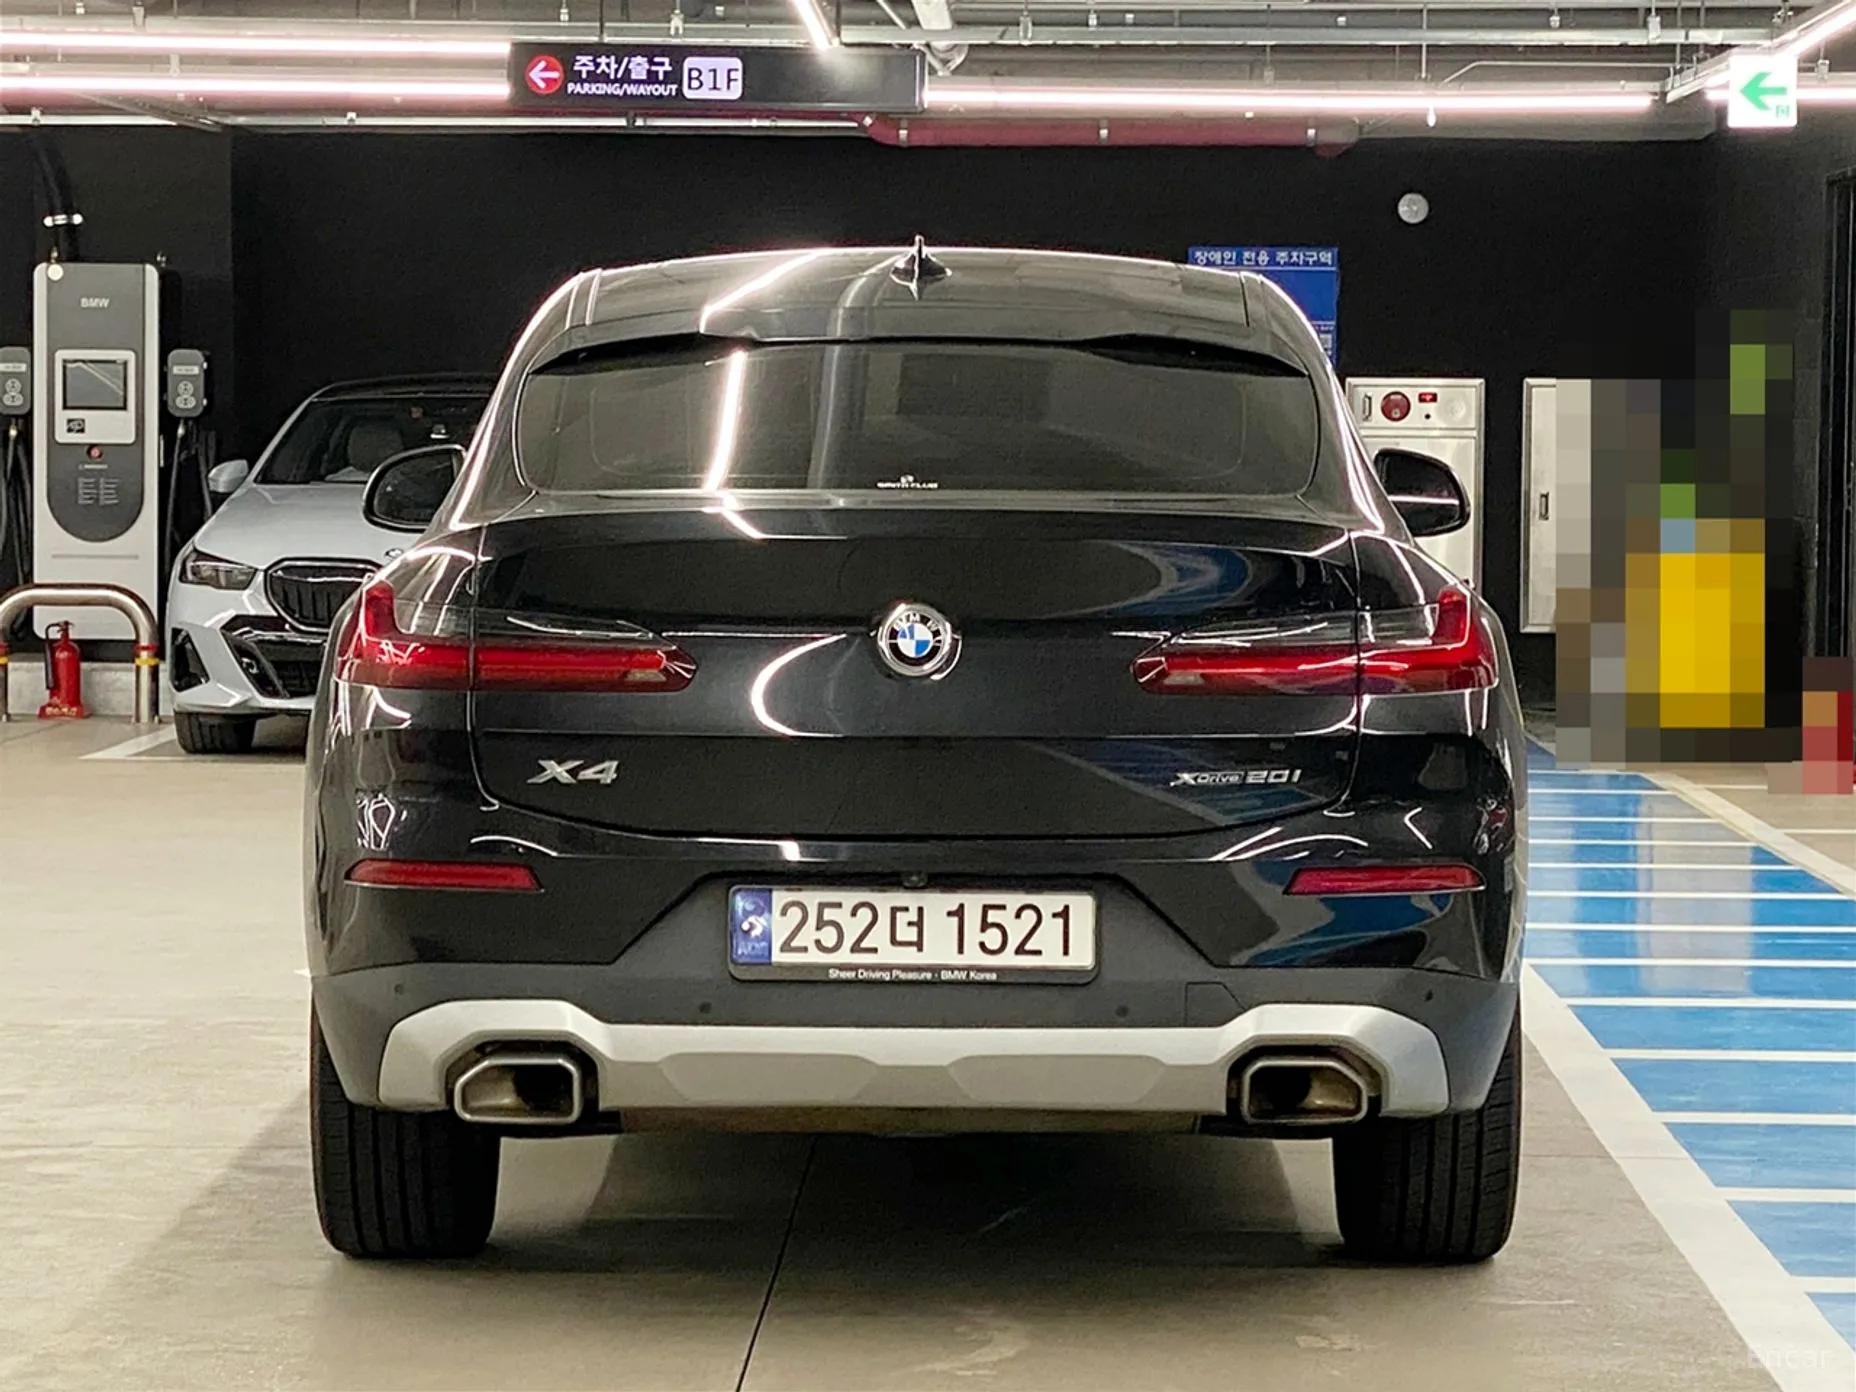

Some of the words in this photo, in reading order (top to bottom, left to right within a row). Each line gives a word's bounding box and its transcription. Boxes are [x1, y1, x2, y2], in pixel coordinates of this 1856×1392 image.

[573, 55, 673, 81] 주차/출구
[567, 82, 678, 97] PARKING/WAYOUT
[687, 68, 740, 92] B1F
[1195, 250, 1236, 266] 장애인
[1243, 250, 1269, 266] 전용
[81, 298, 110, 308] BMW
[526, 759, 619, 784] X4
[779, 900, 924, 955] 252더
[946, 902, 1071, 957] 1521
[828, 968, 857, 979] Sheer
[857, 968, 890, 980] Driving
[892, 968, 932, 980] Pleasure
[940, 970, 968, 981] BMW
[969, 970, 997, 980] Korea
